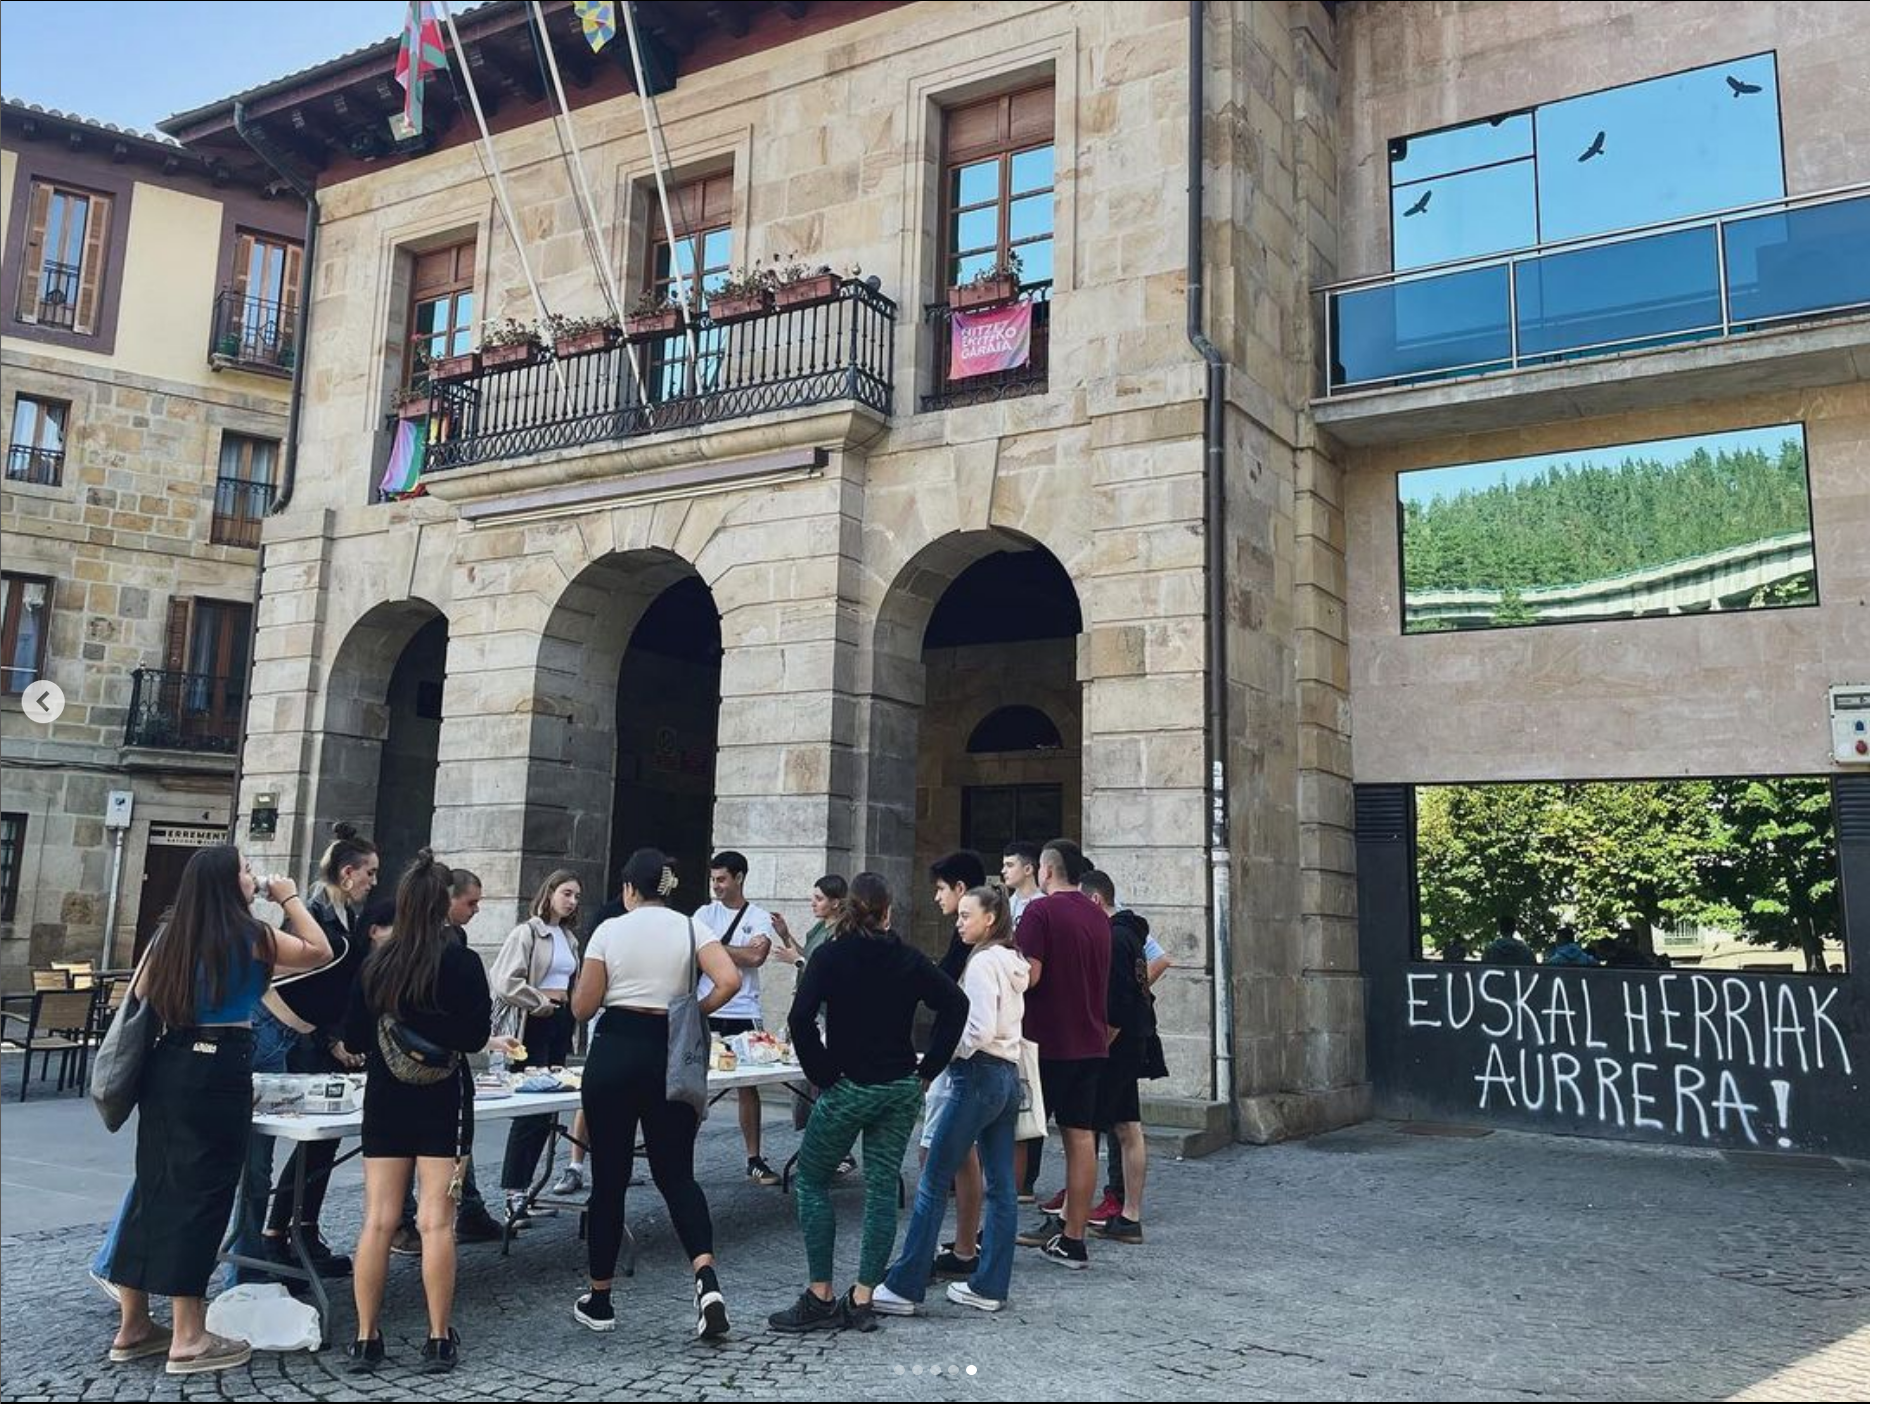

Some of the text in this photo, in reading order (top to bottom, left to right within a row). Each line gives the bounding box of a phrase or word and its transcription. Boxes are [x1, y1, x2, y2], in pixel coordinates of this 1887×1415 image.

[1406, 968, 1852, 1075] EUSKAL HERRIAK
[1474, 1042, 1791, 1149] AURRERA!
